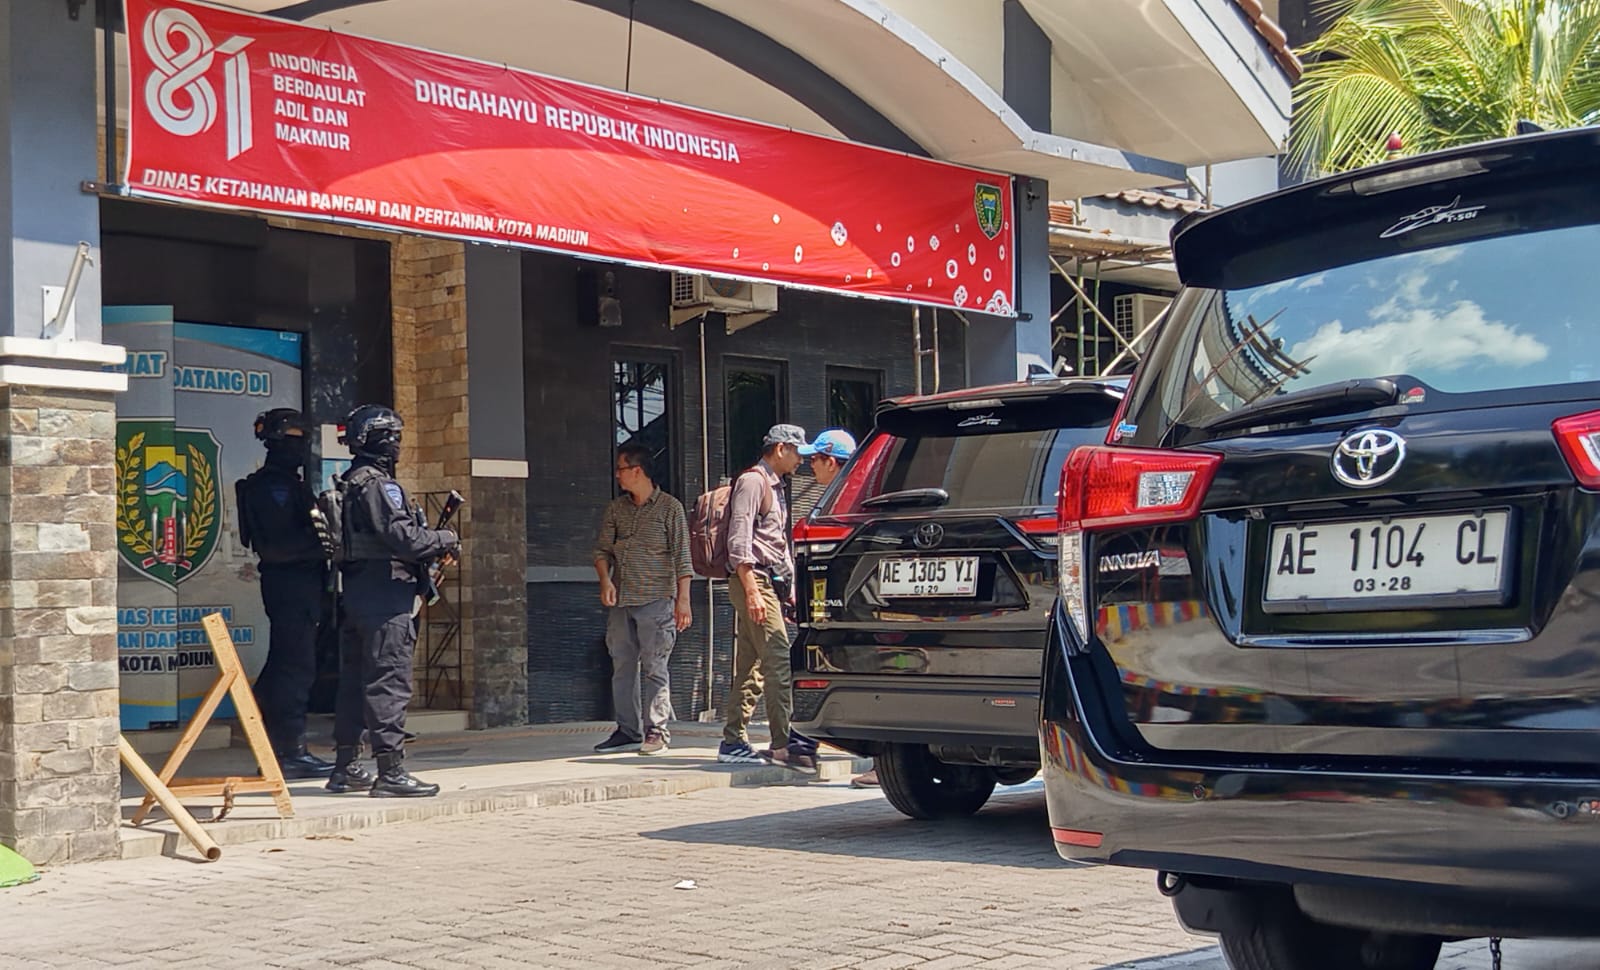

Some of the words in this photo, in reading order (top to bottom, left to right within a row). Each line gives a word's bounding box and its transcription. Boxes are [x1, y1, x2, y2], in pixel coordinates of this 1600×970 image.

[269, 52, 358, 83] INDONESIA
[273, 73, 366, 107] BERDAULAT
[275, 98, 309, 121] ADIL
[312, 106, 348, 127] DAN
[414, 79, 538, 124] DIRGAHAYU
[545, 105, 640, 145] REPUBLIK
[643, 125, 740, 163] INDONESIA
[275, 122, 350, 151] MAKMUR
[143, 168, 200, 192] DINAS
[205, 177, 307, 207] KETAHANAN
[311, 191, 376, 216] PANGAN
[380, 201, 411, 222] DAN
[414, 206, 494, 232] PERTANIAN
[497, 218, 532, 238] KOTA
[536, 224, 589, 246] MADIUN
[247, 371, 270, 395] DI
[1099, 549, 1160, 572] INNOVA
[1277, 530, 1319, 575] AE
[1349, 522, 1426, 572] 1104
[1456, 518, 1498, 566] CL
[882, 562, 901, 583] AE
[908, 561, 946, 582] 1305
[955, 560, 973, 582] YI
[117, 631, 141, 650] AN
[118, 654, 163, 673] KOTA
[166, 651, 214, 673] MDIUN
